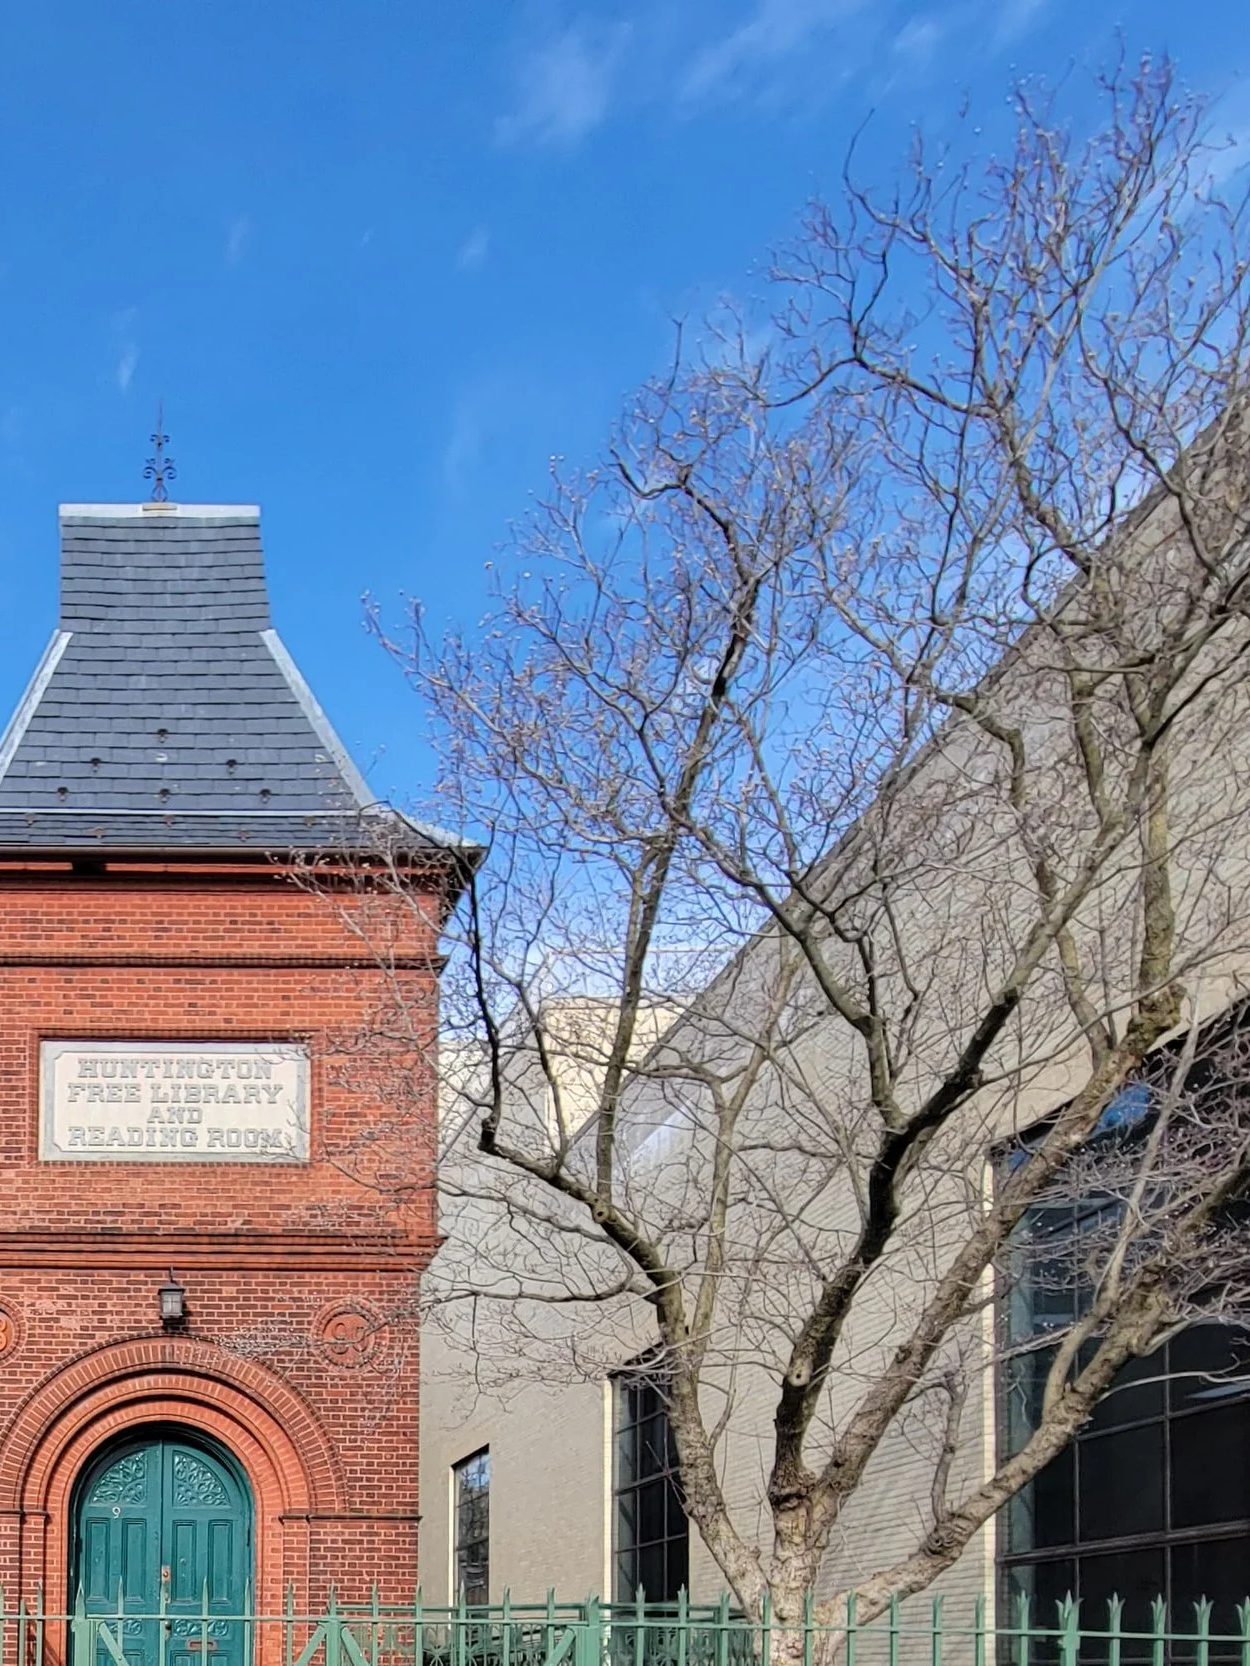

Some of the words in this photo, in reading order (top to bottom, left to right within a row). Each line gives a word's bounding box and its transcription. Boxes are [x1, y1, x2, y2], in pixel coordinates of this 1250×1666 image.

[77, 1058, 272, 1079] HUNTINGTON
[67, 1082, 141, 1103] FREE
[151, 1083, 283, 1104] LIBRARY
[147, 1106, 203, 1124] AND
[68, 1126, 198, 1147] READING
[207, 1127, 283, 1148] ROOM
[112, 1506, 121, 1519] 9
